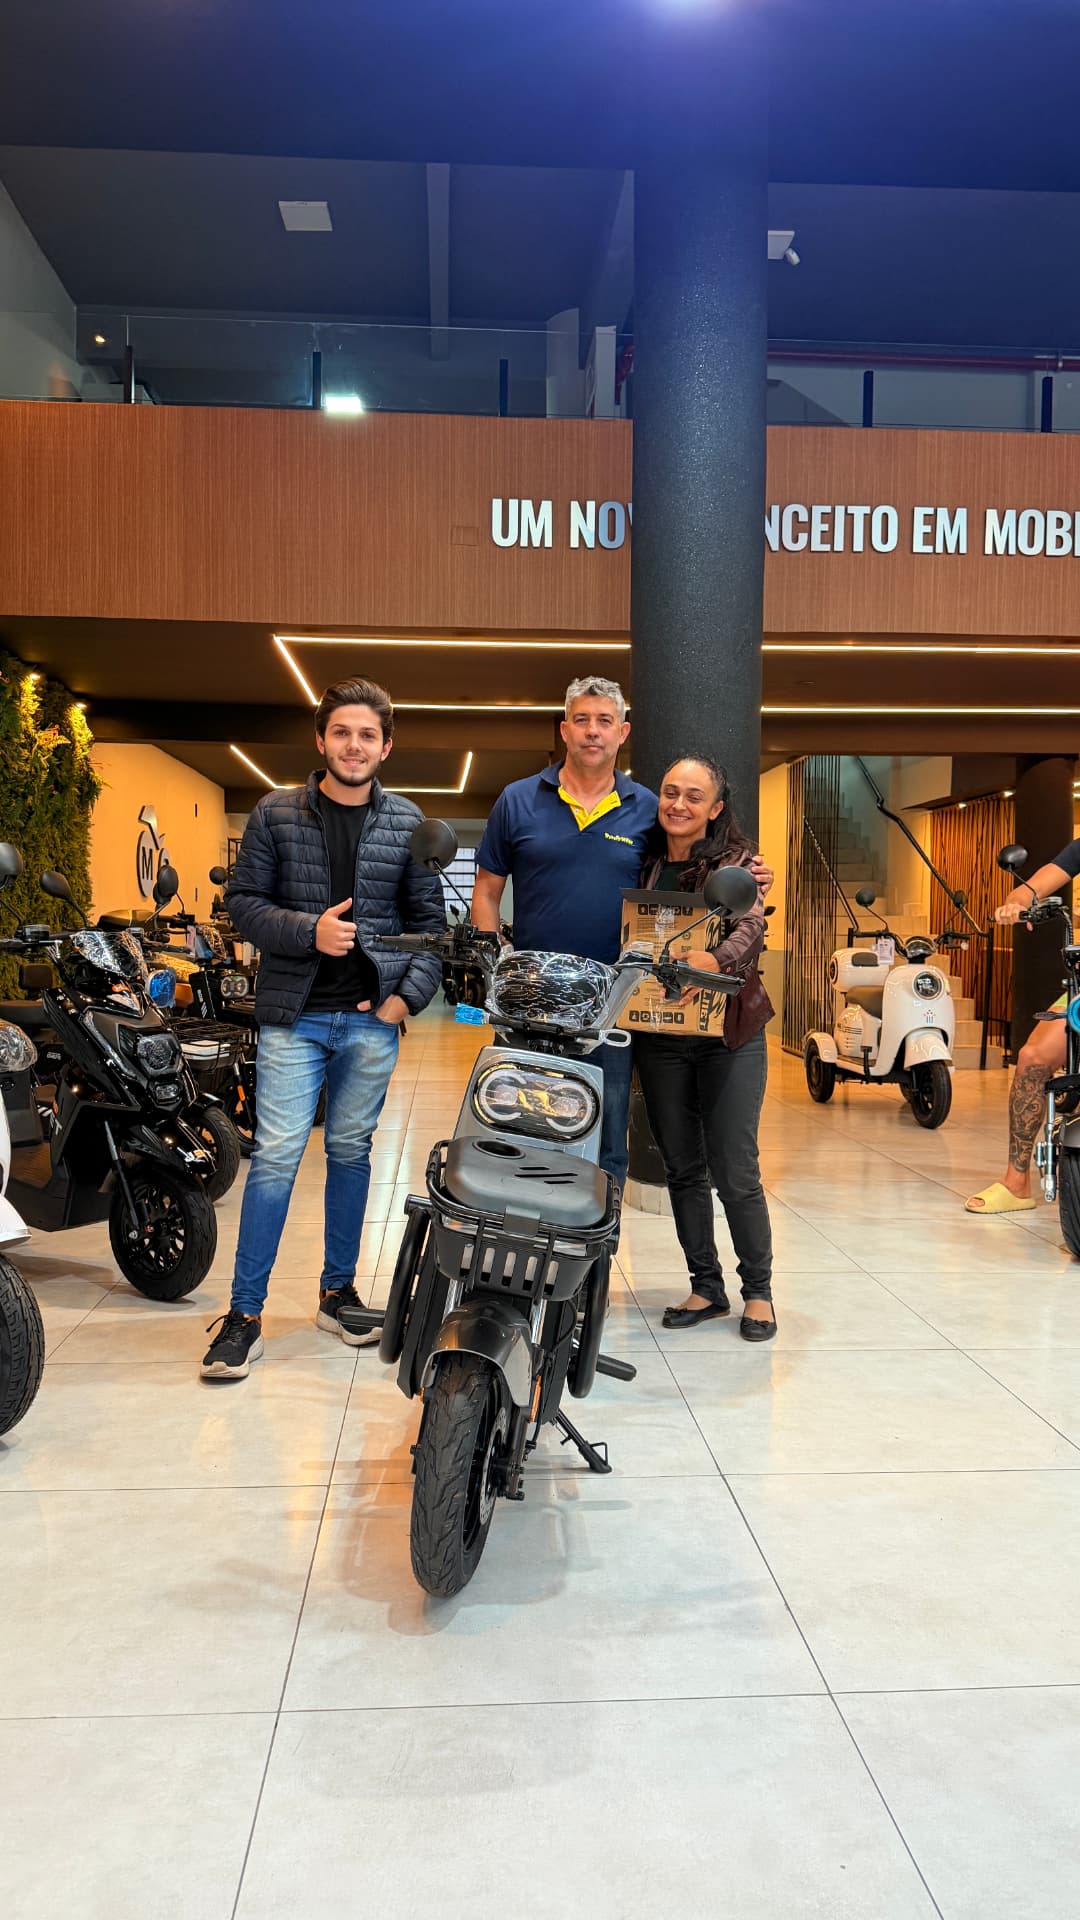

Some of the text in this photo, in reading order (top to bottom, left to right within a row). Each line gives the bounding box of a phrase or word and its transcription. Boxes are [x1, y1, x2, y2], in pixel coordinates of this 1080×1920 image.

[491, 498, 553, 548] UM
[569, 500, 633, 549] NO
[912, 506, 968, 555] EM
[141, 846, 153, 881] M
